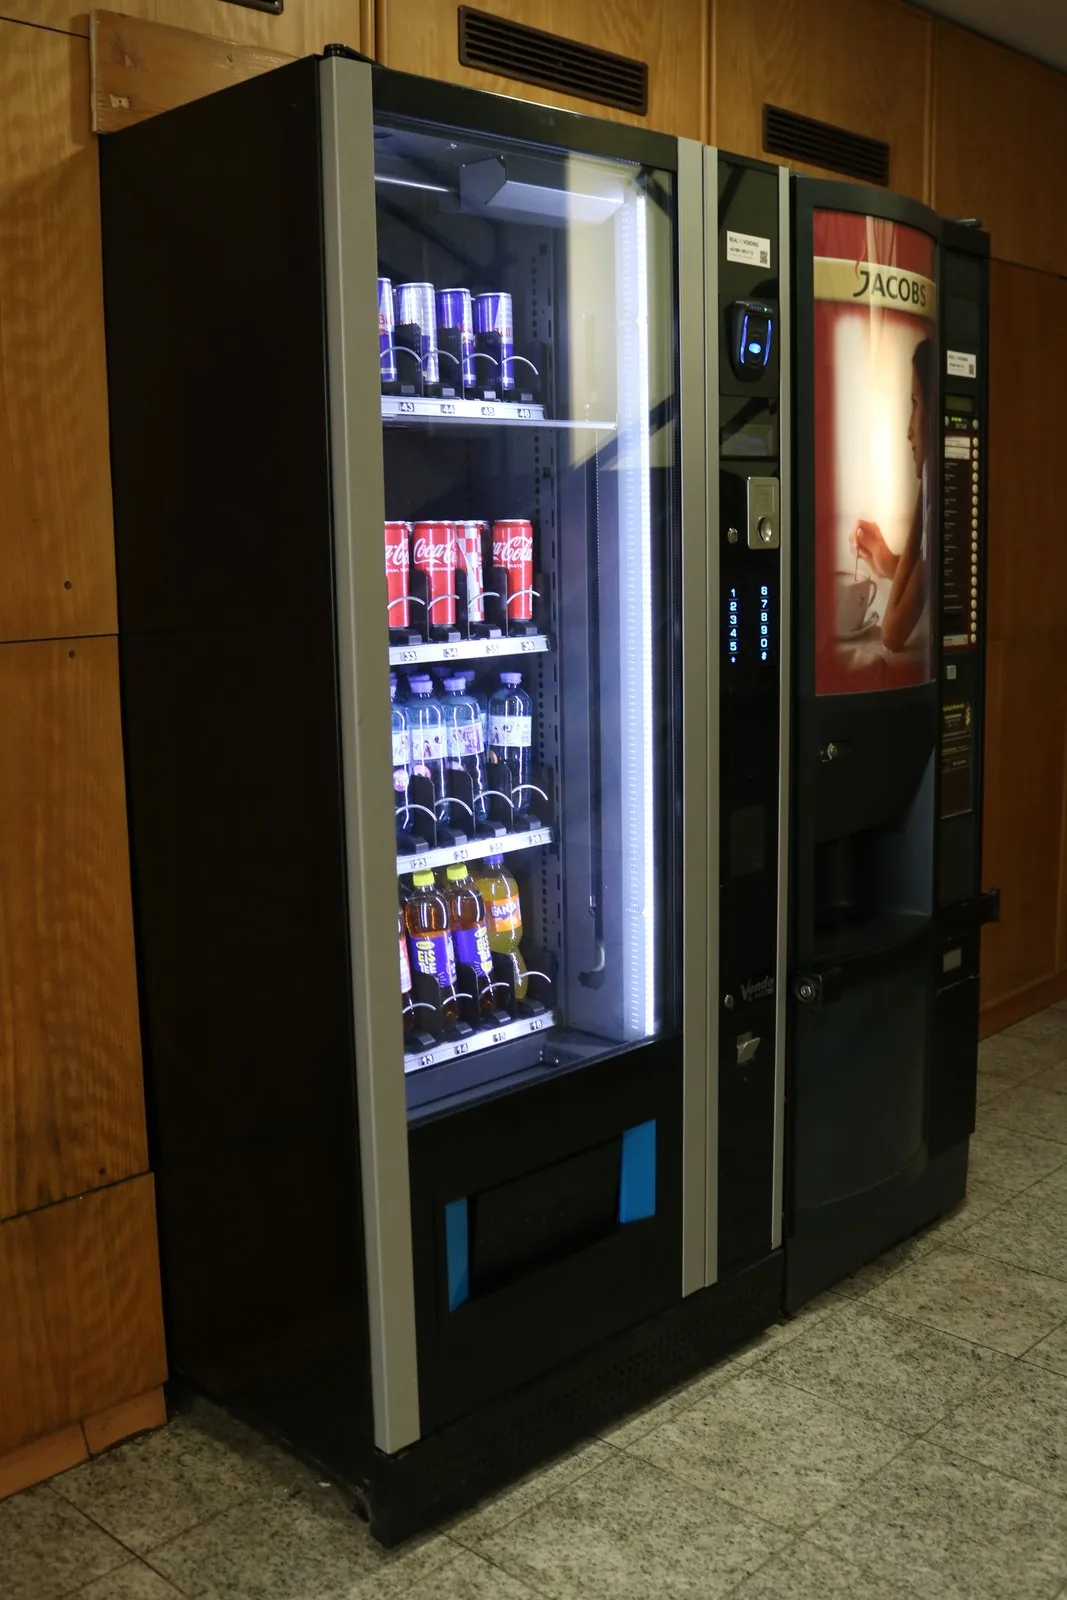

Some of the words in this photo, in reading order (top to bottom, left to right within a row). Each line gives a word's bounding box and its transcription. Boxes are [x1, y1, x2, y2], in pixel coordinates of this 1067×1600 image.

[853, 270, 926, 307] JACOBS
[400, 402, 415, 413] 43
[731, 588, 736, 597] 1
[761, 586, 768, 595] 6
[730, 602, 737, 611] 2
[761, 599, 768, 608] 7
[730, 615, 737, 625] 3
[761, 612, 768, 622] 8
[730, 628, 737, 637] 4
[761, 625, 768, 635] 9
[730, 641, 737, 651] 5
[761, 638, 768, 648] 0
[419, 1055, 434, 1066] 13
